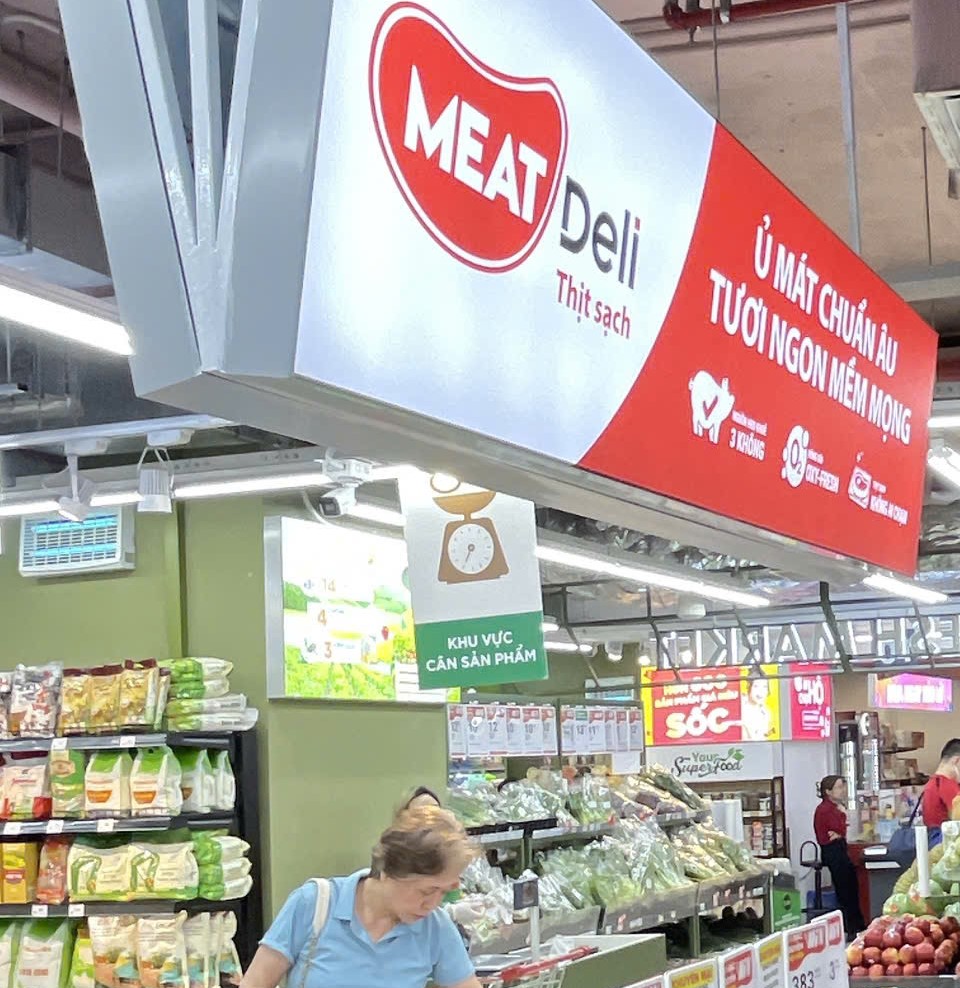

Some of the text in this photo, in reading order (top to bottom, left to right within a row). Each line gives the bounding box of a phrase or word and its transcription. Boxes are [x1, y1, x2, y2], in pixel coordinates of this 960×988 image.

[403, 64, 548, 224] MEAT
[560, 175, 642, 290] Deli
[556, 268, 631, 340] Thịt sạch
[754, 214, 773, 280] Ủ
[773, 243, 820, 315] MÁT
[875, 323, 898, 377] ÂU
[709, 268, 768, 354] TƯƠI
[768, 314, 828, 392] NGON
[868, 385, 912, 445] MỌNG
[729, 428, 765, 461] 3 KHÔNG
[425, 643, 537, 672] CÂN SẢN PHẨM
[447, 631, 513, 653] KHU VỰC
[665, 703, 730, 739] SỐC
